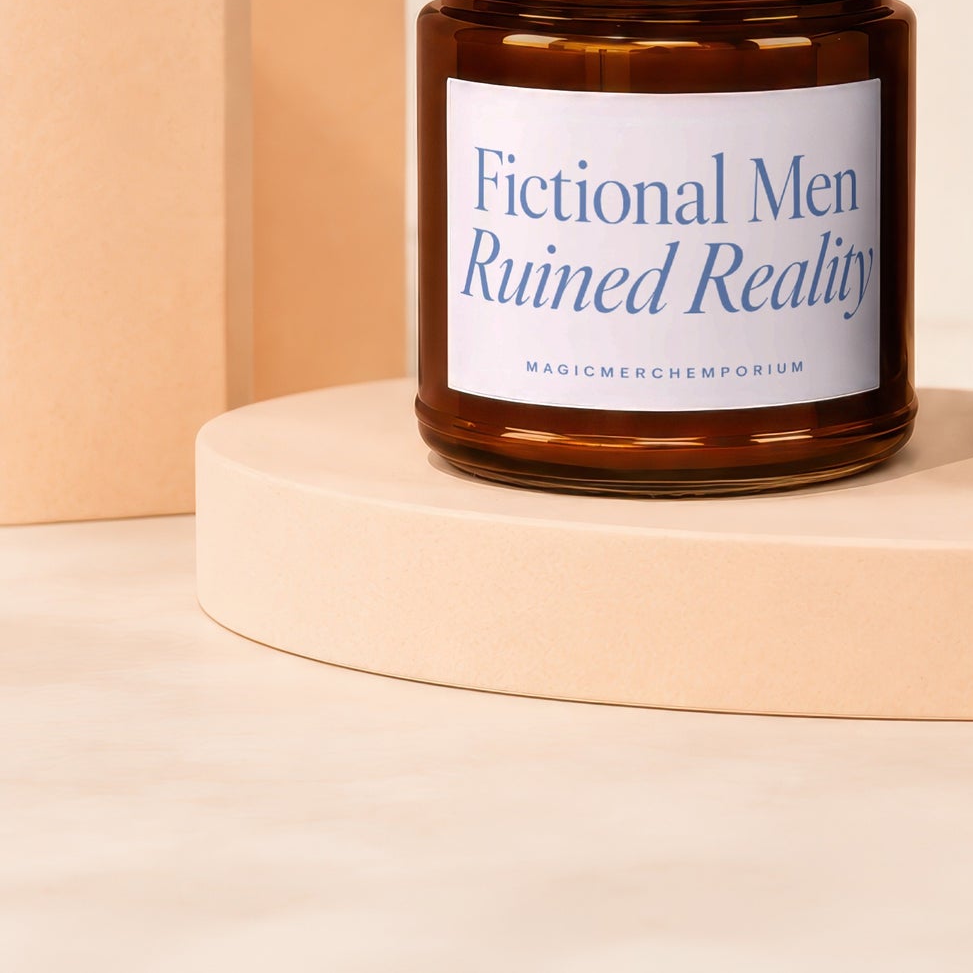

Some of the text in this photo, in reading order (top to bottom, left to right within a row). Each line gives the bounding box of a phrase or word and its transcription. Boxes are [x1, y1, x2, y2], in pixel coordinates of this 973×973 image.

[474, 146, 859, 226] Fictional Men
[460, 227, 875, 321] Ruined Reality
[526, 360, 806, 379] MAGICMERCHEMPORIUM
